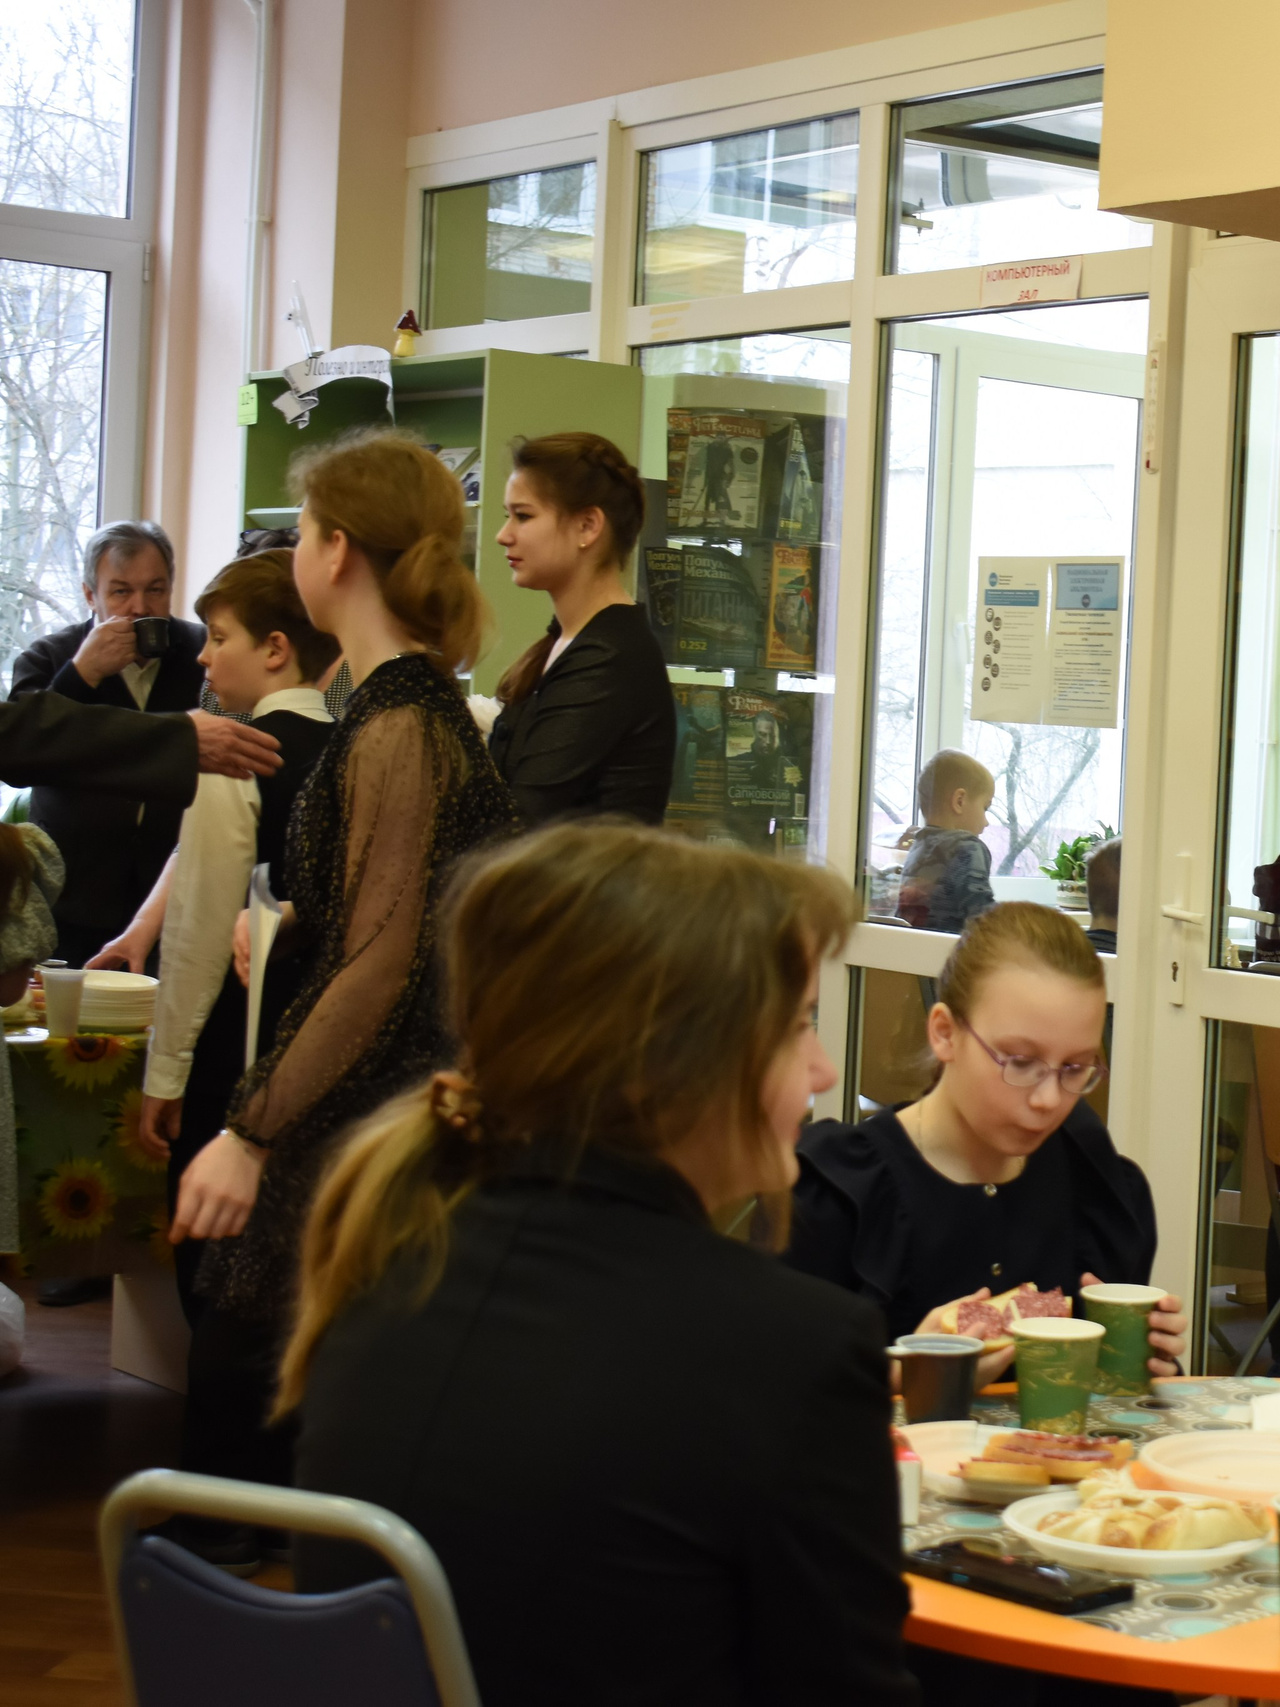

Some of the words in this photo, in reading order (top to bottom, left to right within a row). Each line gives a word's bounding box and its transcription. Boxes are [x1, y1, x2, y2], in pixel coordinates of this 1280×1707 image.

[986, 259, 1070, 282] КОМПЬЮТЕРНЫЙ
[1018, 289, 1039, 300] ЗАЛ
[680, 640, 707, 649] 0.252
[728, 786, 790, 800] Сапковский
